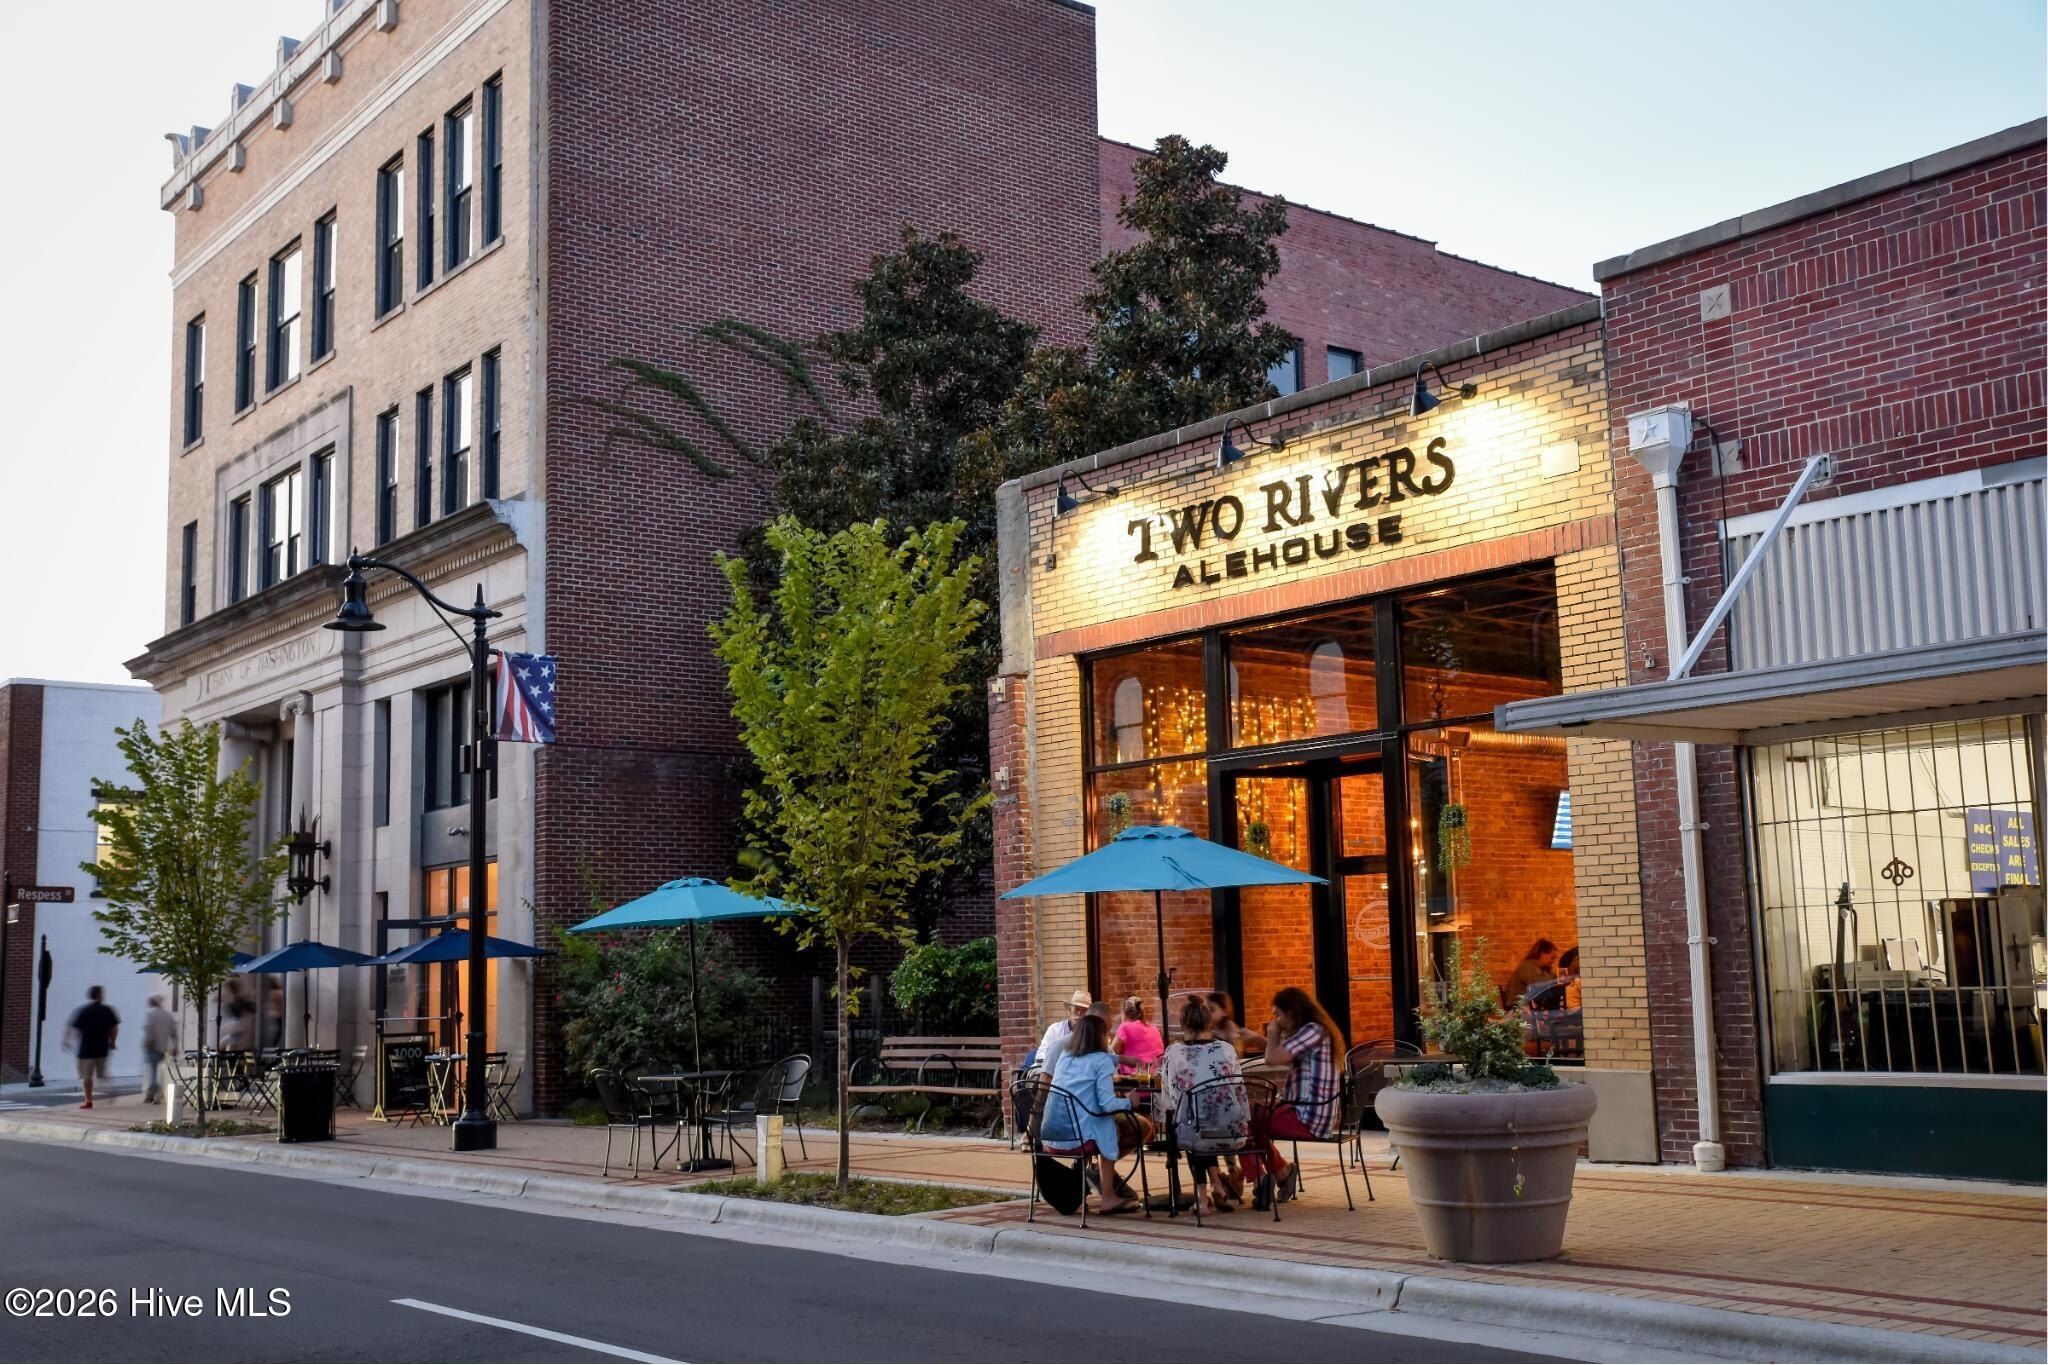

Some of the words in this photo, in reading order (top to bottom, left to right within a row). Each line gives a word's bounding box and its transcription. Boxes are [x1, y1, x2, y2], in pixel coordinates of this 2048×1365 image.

[1128, 496, 1244, 563] TWO
[1260, 437, 1455, 532] RIVERS
[1172, 515, 1403, 589] ALEHOUSE
[240, 660, 252, 681] OF
[257, 635, 316, 673] WASHINGTON
[1973, 823, 1996, 835] NO
[2008, 816, 2025, 830] ALL
[2002, 835, 2031, 848] SALES
[2005, 872, 2031, 885] FINAL
[17, 888, 63, 902] Respess
